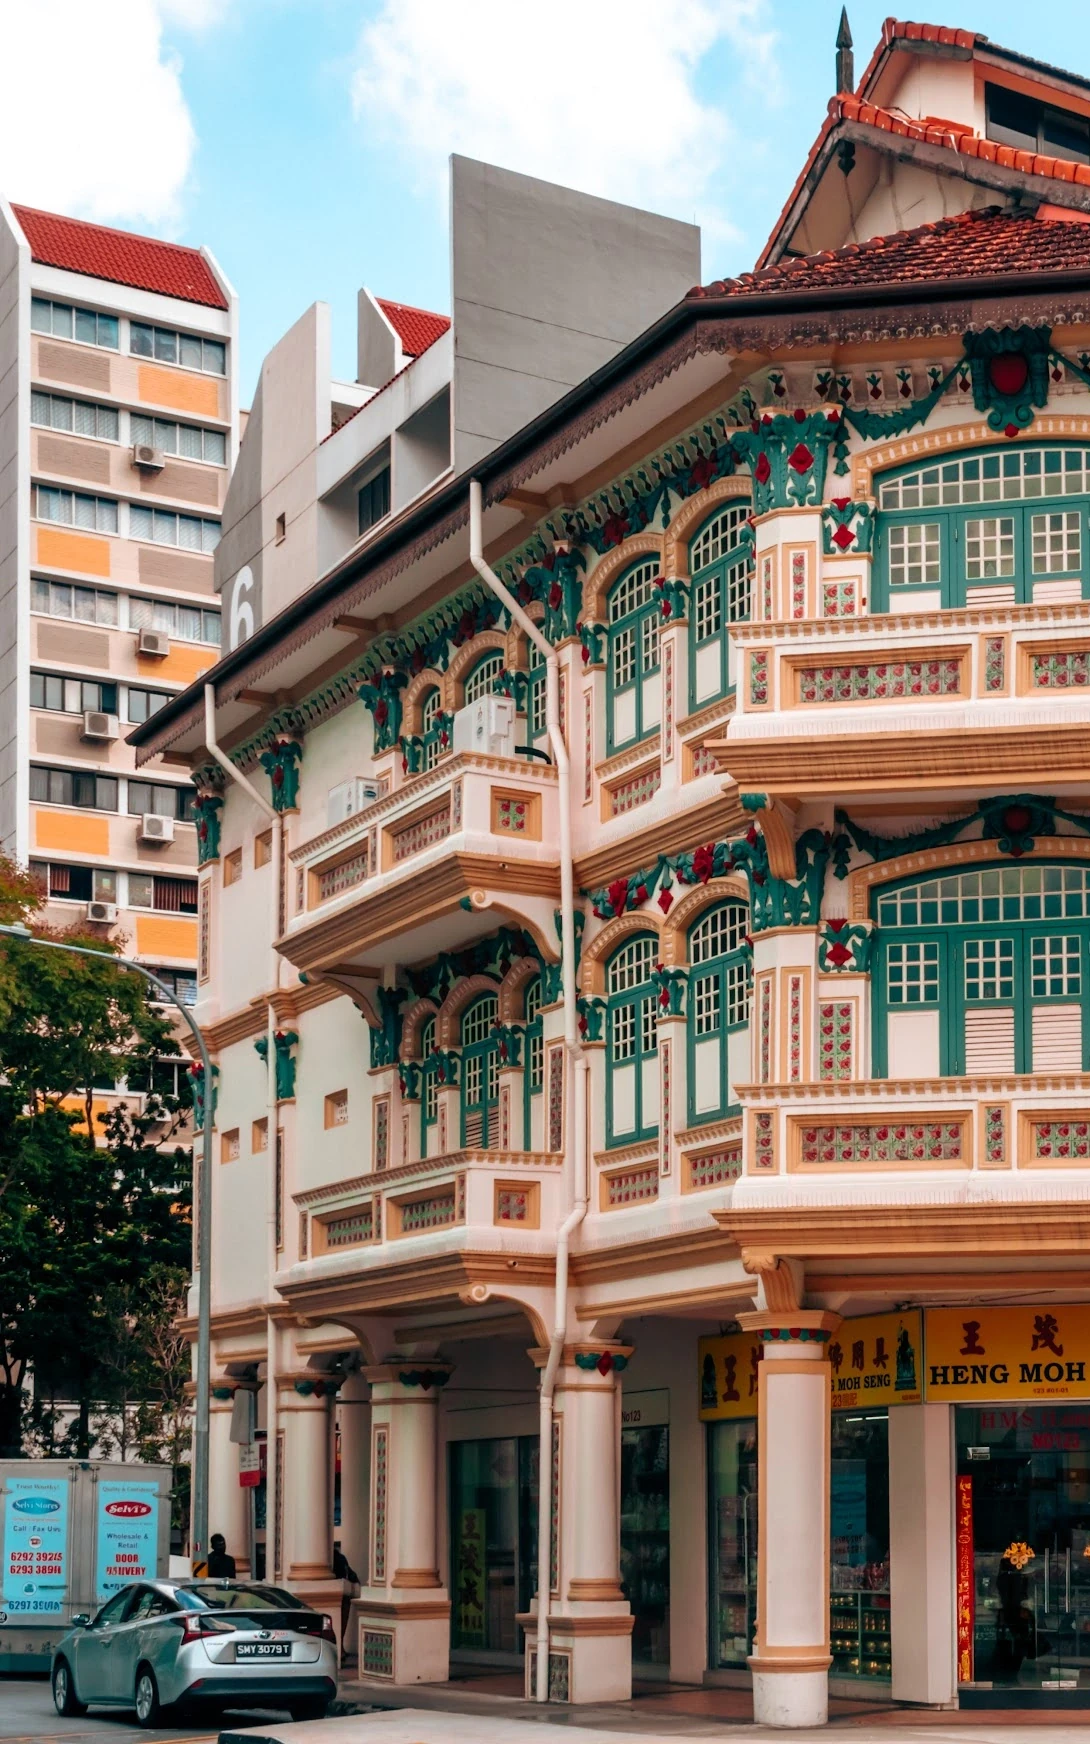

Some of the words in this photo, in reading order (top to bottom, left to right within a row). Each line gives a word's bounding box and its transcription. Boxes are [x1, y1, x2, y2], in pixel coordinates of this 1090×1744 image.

[930, 1364, 1010, 1386] HENG
[1019, 1361, 1087, 1384] MOH
[838, 1376, 861, 1392] MOH
[864, 1373, 891, 1389] SENG
[108, 1504, 147, 1514] Selvi's
[11, 1552, 33, 1561] 6292
[115, 1553, 139, 1563] DOOR
[10, 1565, 33, 1574] 6293
[8, 1600, 31, 1610] 6297
[237, 1644, 257, 1655] SMY
